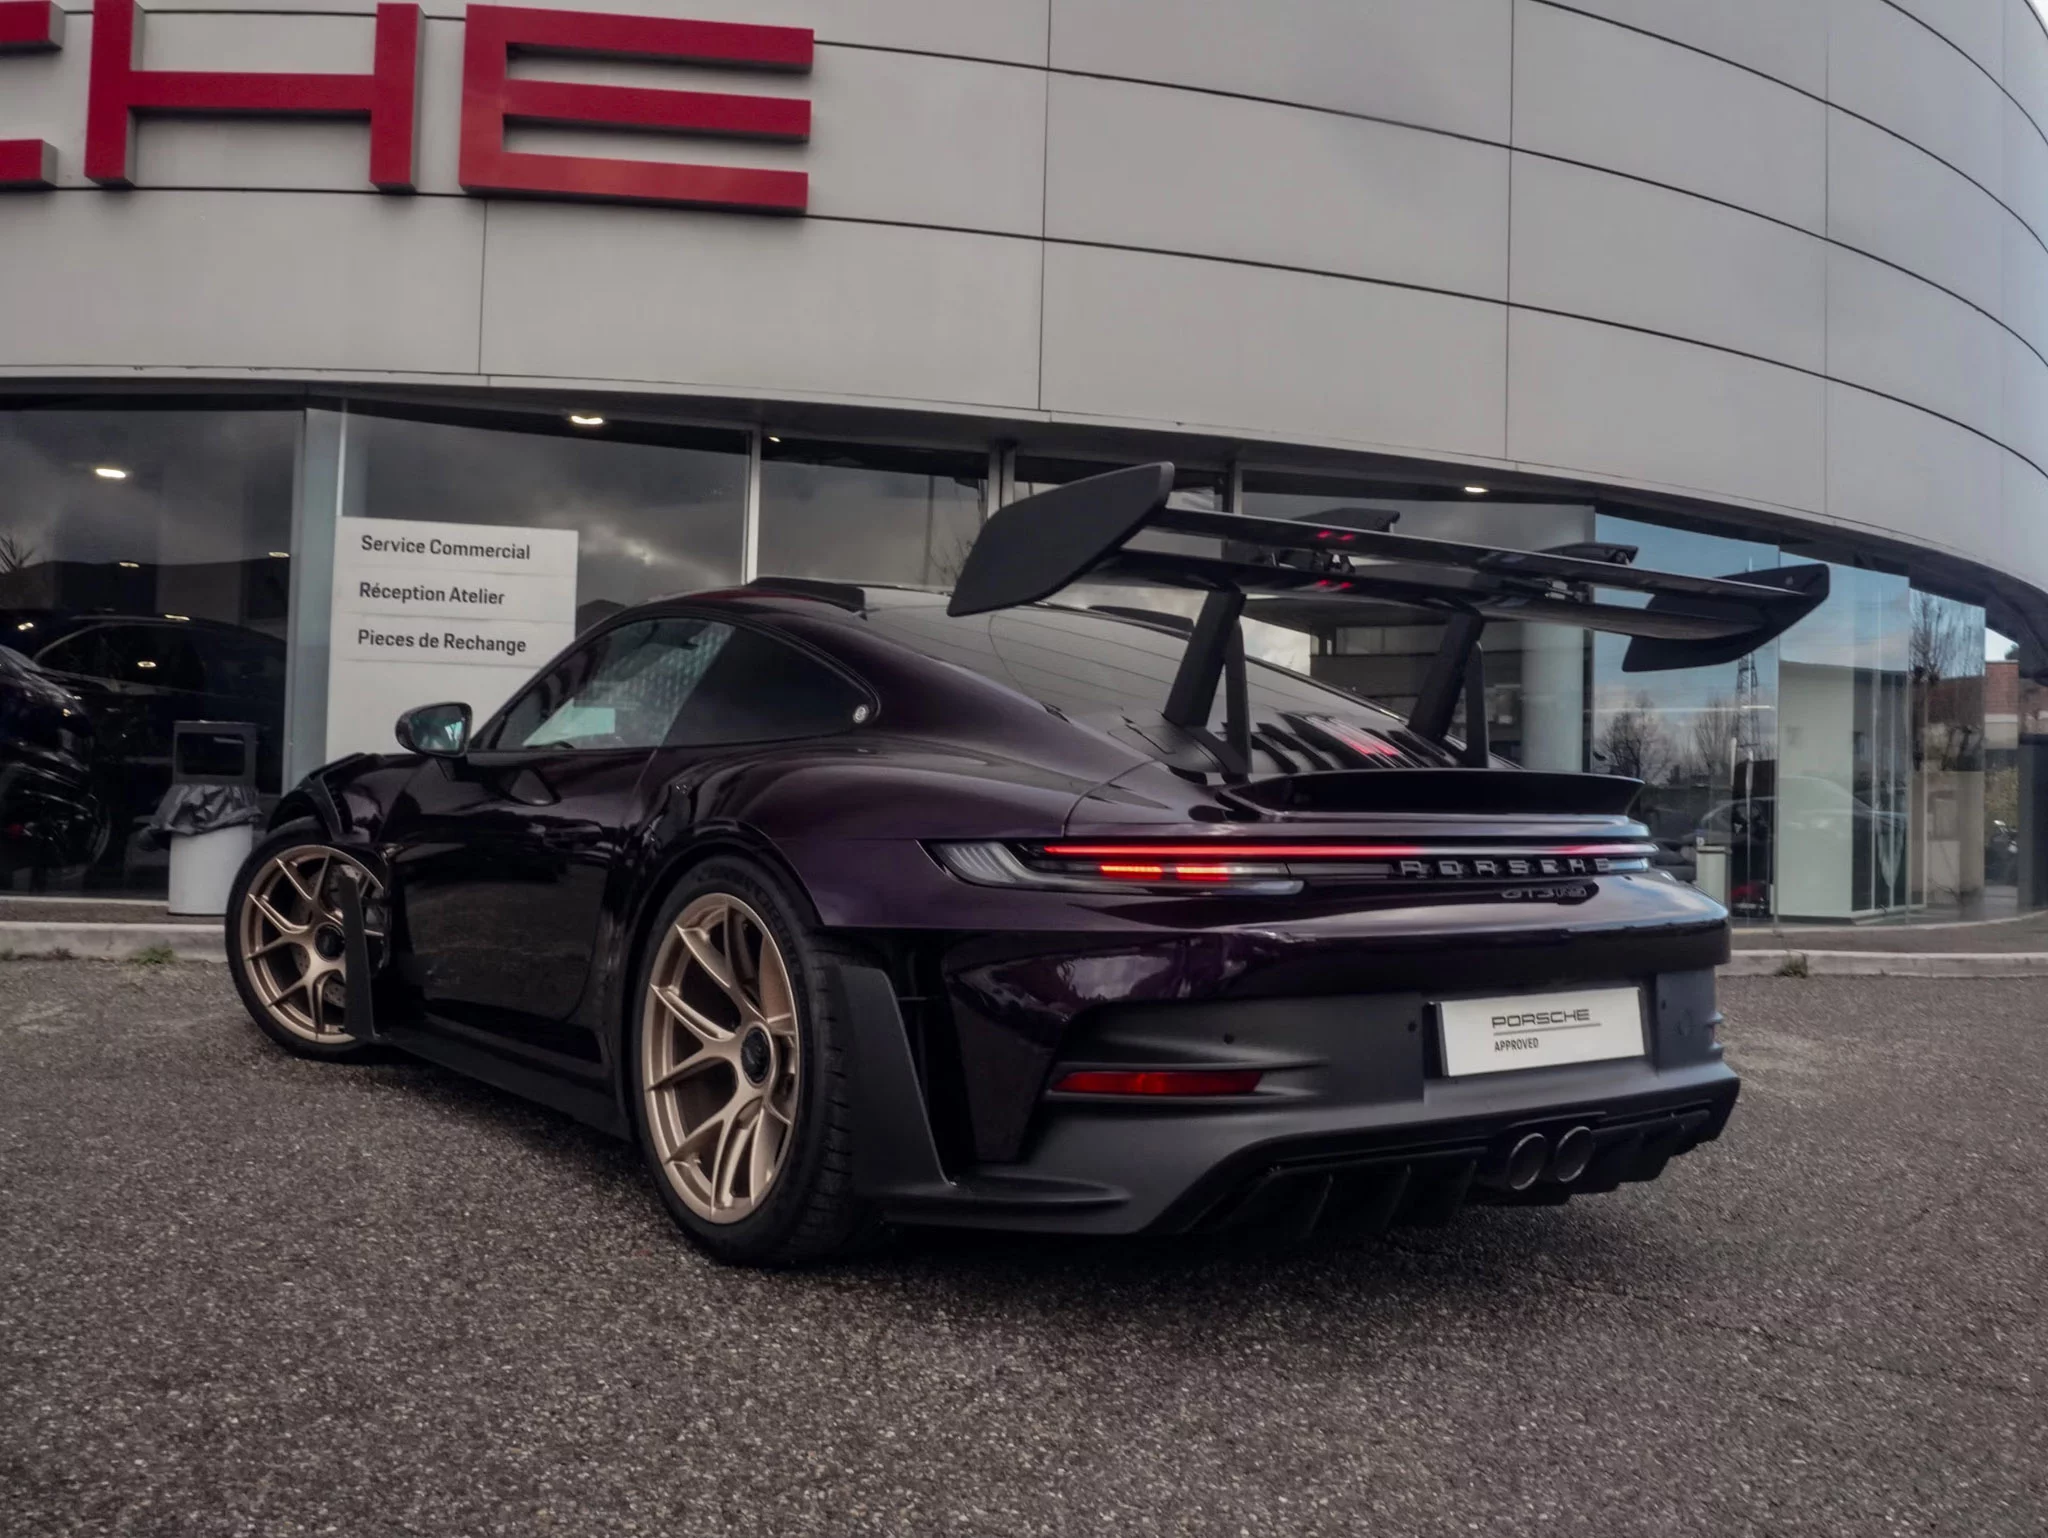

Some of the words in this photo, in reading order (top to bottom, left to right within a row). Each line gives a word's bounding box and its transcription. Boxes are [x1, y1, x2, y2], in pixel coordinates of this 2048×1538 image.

[0, 0, 814, 214] HE
[361, 535, 425, 553] Service
[430, 539, 531, 560] Commercial
[359, 582, 446, 603] Réception
[449, 587, 506, 604] Atelier
[357, 629, 414, 646] Pieces
[419, 633, 439, 648] de
[443, 633, 527, 656] Rechange
[1491, 1008, 1590, 1029] PORSCHE
[1494, 1037, 1539, 1052] APPROVED
